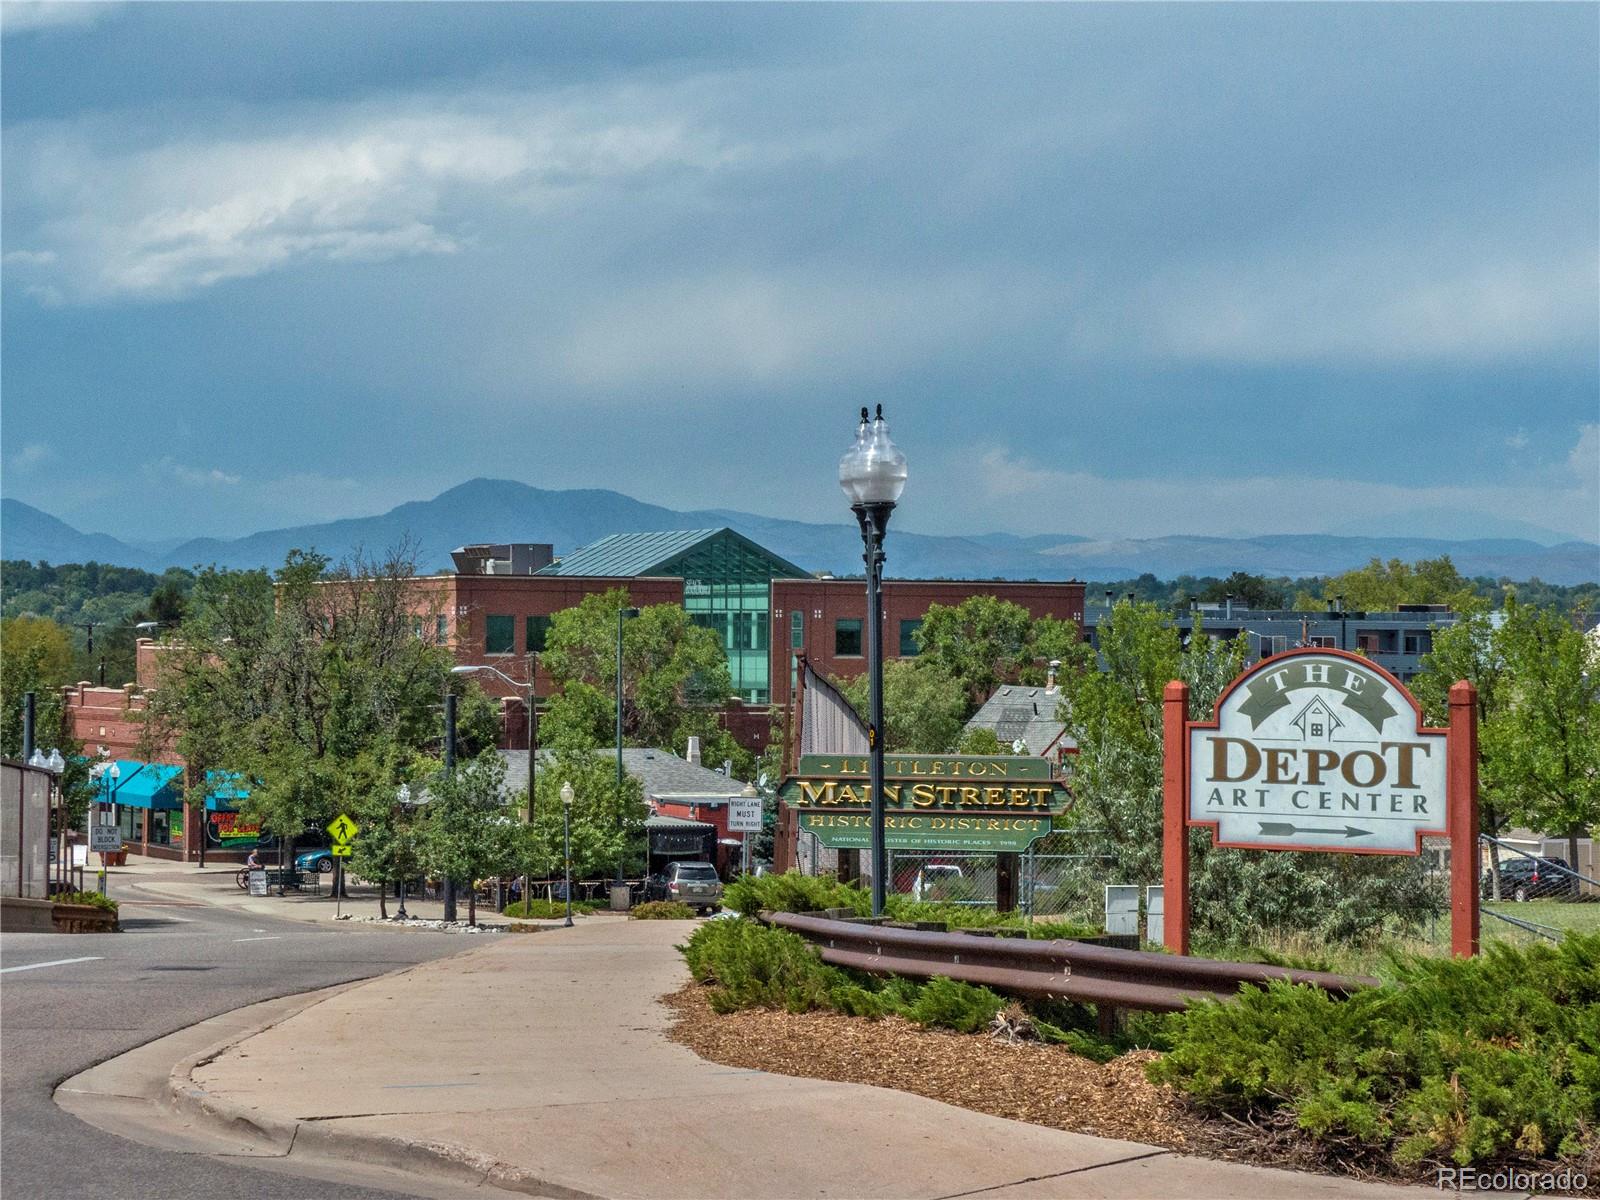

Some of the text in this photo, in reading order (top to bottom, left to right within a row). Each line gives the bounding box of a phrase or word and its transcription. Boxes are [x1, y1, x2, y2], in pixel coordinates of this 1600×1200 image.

[1266, 664, 1366, 695] THE
[840, 760, 1008, 776] LITLETON
[1206, 737, 1431, 789] DEPOT
[796, 781, 1052, 806] MAIN STREET
[1207, 788, 1429, 814] ART CENTER
[930, 817, 1042, 831] DISTRICT
